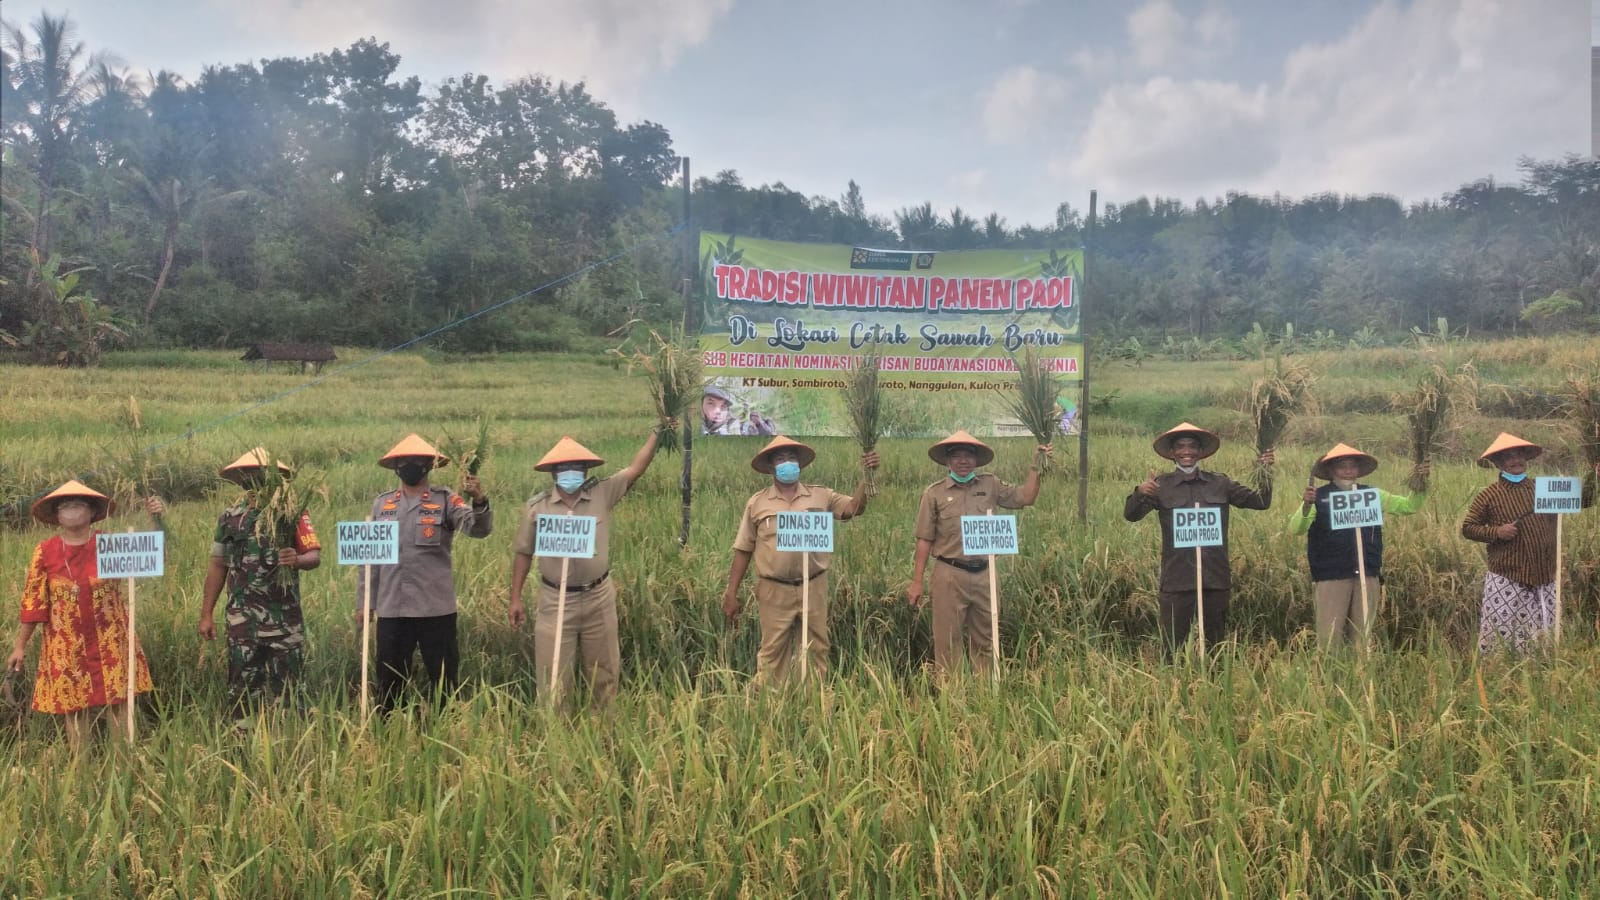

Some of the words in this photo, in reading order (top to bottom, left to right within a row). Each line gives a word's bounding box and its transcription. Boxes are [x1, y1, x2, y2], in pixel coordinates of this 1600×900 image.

[714, 264, 809, 305] TRADISI
[812, 273, 926, 308] WIWITAN
[928, 276, 1012, 310] PANEN
[1014, 276, 1072, 310] PADI
[729, 315, 758, 346] Di
[768, 317, 840, 351] Lokasi
[850, 321, 911, 350] Cetak
[919, 324, 994, 351] Sawah
[1003, 323, 1064, 352] Baru
[704, 351, 727, 367] SUB
[794, 354, 851, 370] NOMINASI
[742, 377, 756, 387] KT
[758, 378, 790, 389] Subur,
[792, 378, 848, 389] Sambiroto,
[909, 381, 967, 392] Nanggulan,
[969, 381, 1000, 390] Kulon
[1547, 480, 1572, 493] LURAH
[1332, 491, 1377, 510] BPP
[1536, 497, 1580, 510] BANYUROTO
[778, 514, 811, 530] DINAS
[814, 515, 828, 530] PU
[1176, 511, 1217, 527] DPRD
[1333, 508, 1379, 526] NANGGULAN
[339, 524, 393, 541] KAPOLSEK
[538, 517, 591, 535] PANEWU
[963, 519, 1013, 535] DIPERTAPA
[1175, 528, 1198, 542] KULON
[1198, 527, 1220, 541] PROGO
[98, 535, 159, 554] DANRAMIL
[538, 536, 589, 553] NANGGULAN
[777, 533, 802, 548] KULON
[804, 534, 829, 548] PROGO
[965, 535, 989, 550] KULON
[990, 535, 1015, 549] PROGO
[341, 543, 392, 560] NANGGULAN
[100, 555, 156, 574] NANGGULAN
